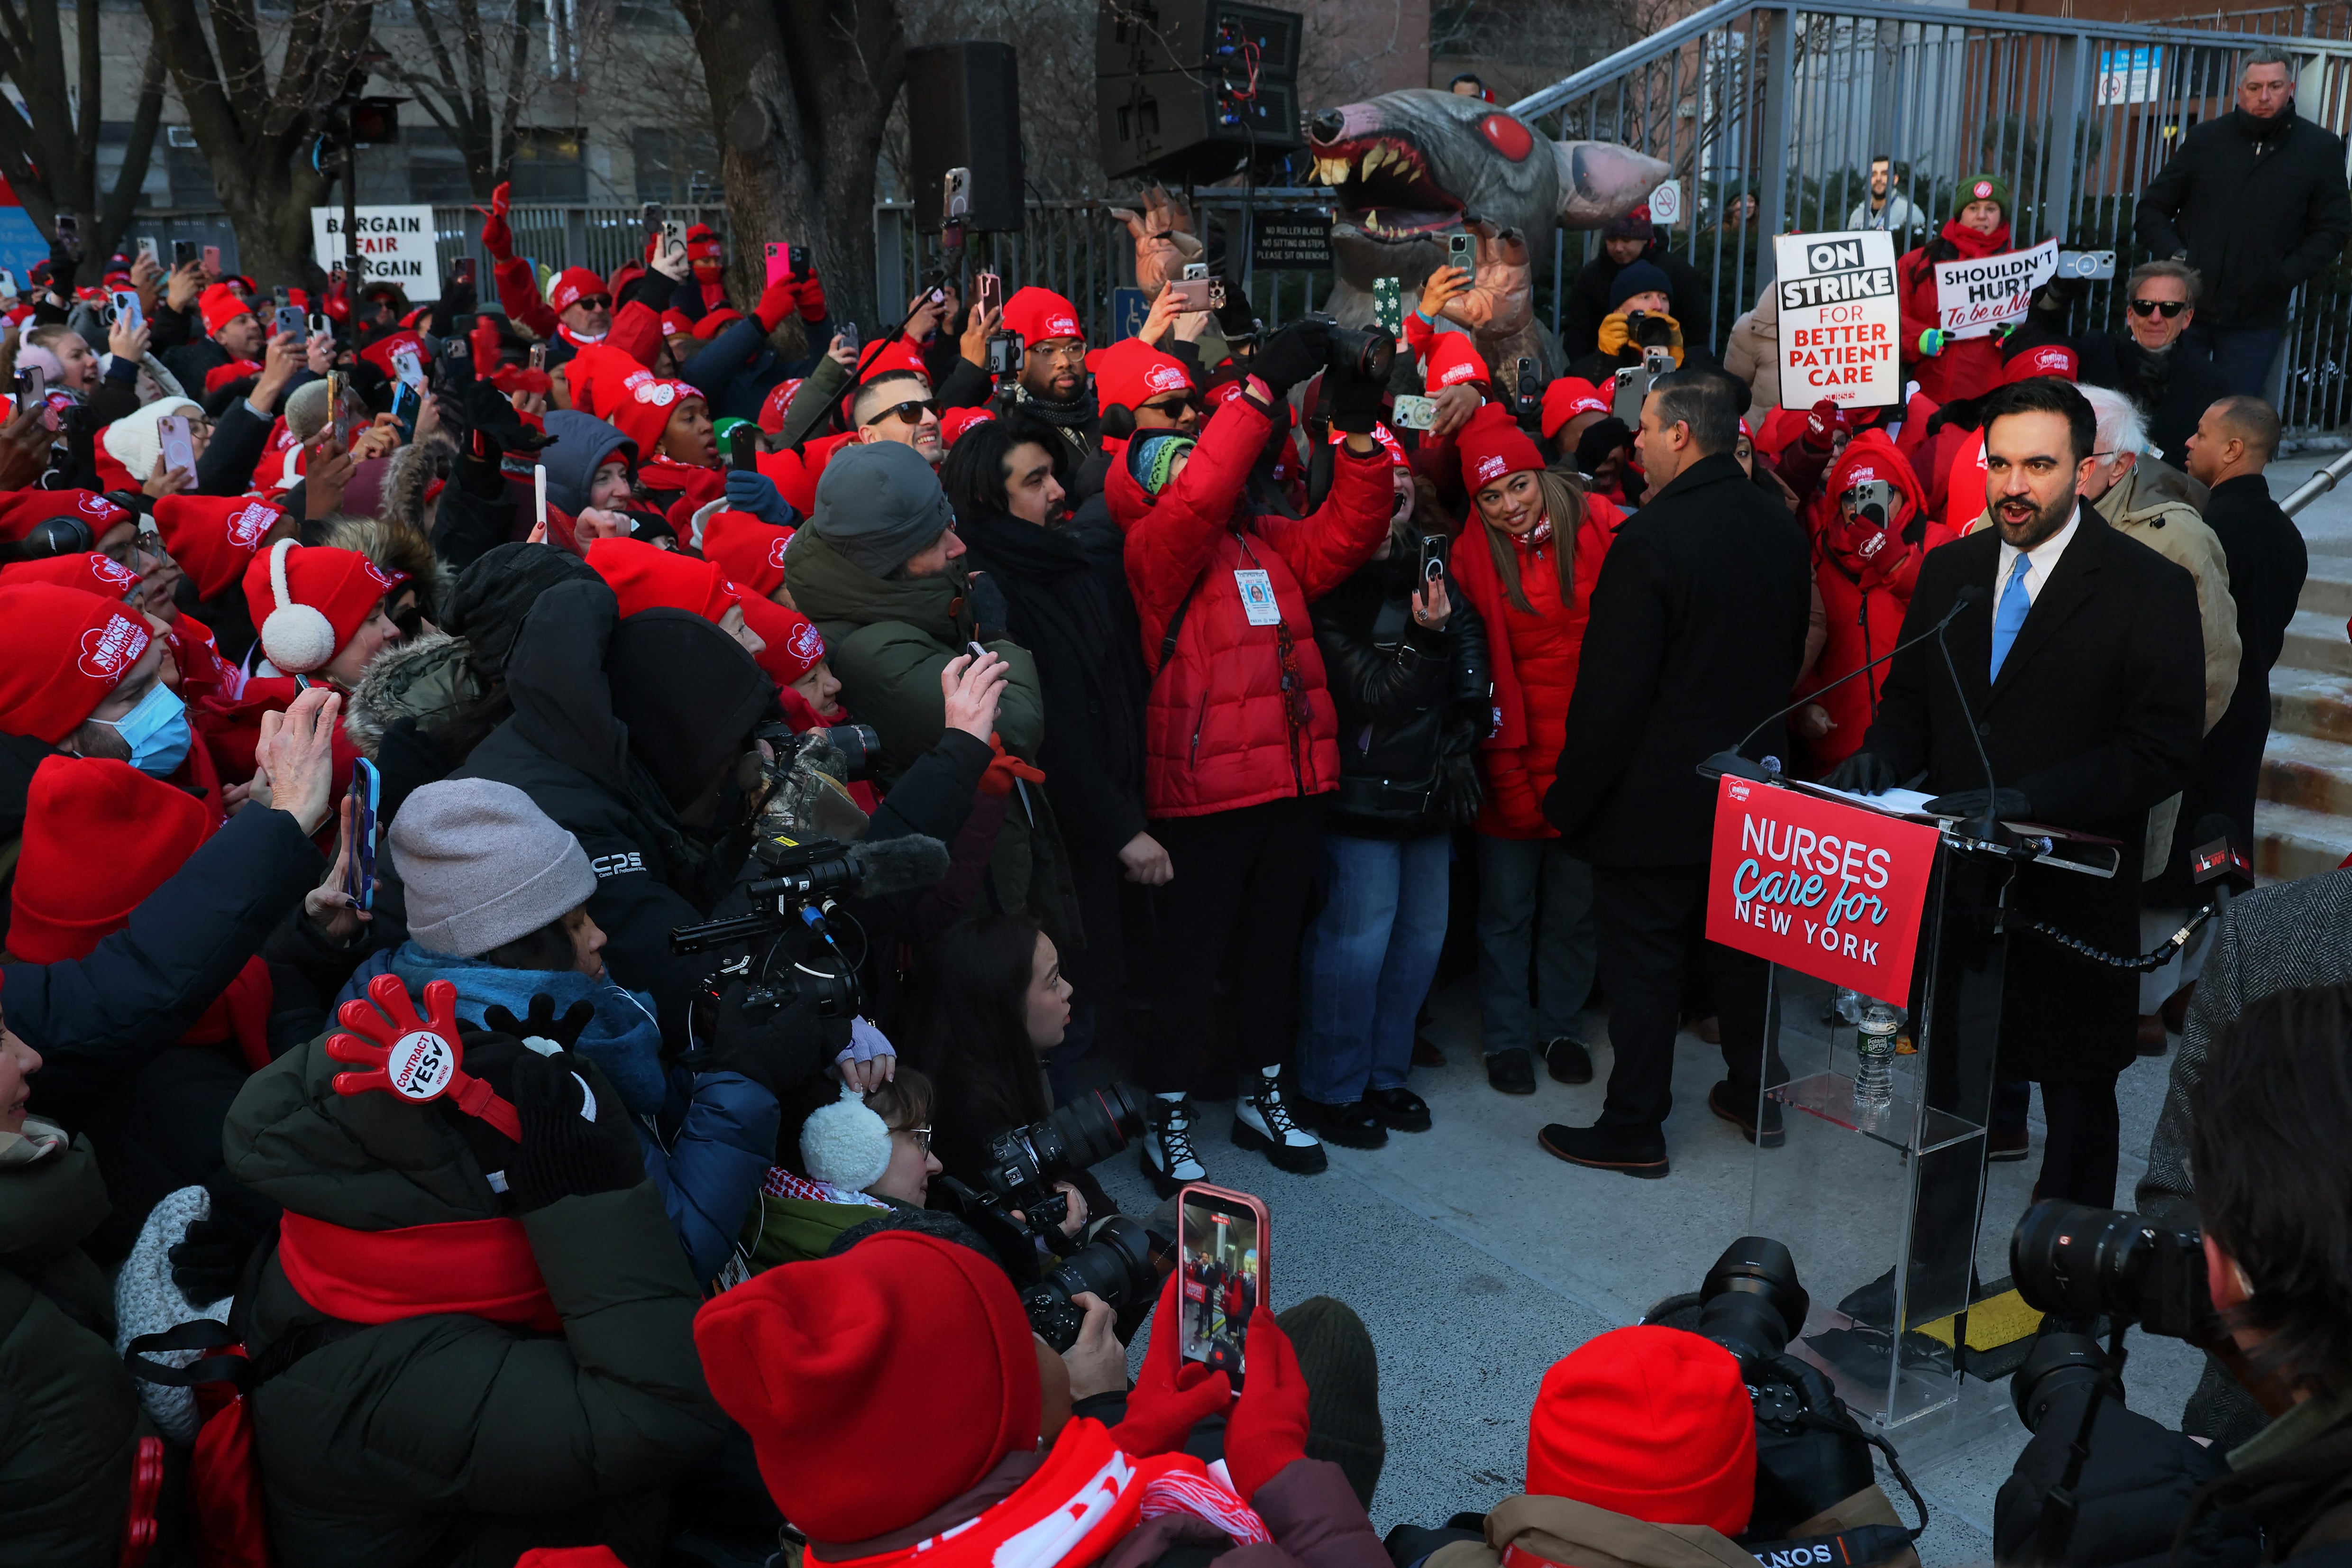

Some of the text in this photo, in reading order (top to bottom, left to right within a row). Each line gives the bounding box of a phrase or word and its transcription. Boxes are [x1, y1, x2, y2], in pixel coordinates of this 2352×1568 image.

[327, 216, 420, 233] BRGAIN
[1265, 226, 1275, 235] NO
[1276, 226, 1301, 235] ROLLER
[356, 237, 398, 253] FAIR
[1256, 250, 1282, 259] PLEASE
[1284, 251, 1294, 259] SIT
[1262, 238, 1272, 248] NO
[1273, 238, 1298, 248] SITTING
[1308, 239, 1326, 248] STEPS
[332, 260, 421, 276] BRGAIN
[1811, 242, 1859, 271] ON
[1945, 250, 2052, 285] SHOULDN'T
[1784, 269, 1891, 308] STRIKE
[1968, 274, 2034, 303] HURT
[1820, 305, 1863, 324] FOR
[1948, 306, 1966, 327] To
[1970, 303, 1988, 321] be
[1993, 305, 2004, 316] a
[1795, 323, 1886, 347] BETTER
[1790, 343, 1892, 367] PATIENT
[1808, 366, 1873, 386] CARE
[1823, 391, 1856, 402] NURSES
[92, 617, 130, 668] NURSES
[95, 632, 107, 647] New
[102, 623, 115, 635] York
[591, 852, 642, 874] CPS
[1742, 813, 1891, 889] NURSES
[1733, 858, 1888, 926] Care for
[1734, 898, 1879, 965] NEW YORK
[1868, 1036, 1887, 1045] Poland
[1868, 1043, 1887, 1051] Spring
[396, 1034, 430, 1088] CONTRACT
[406, 1054, 439, 1094] YES
